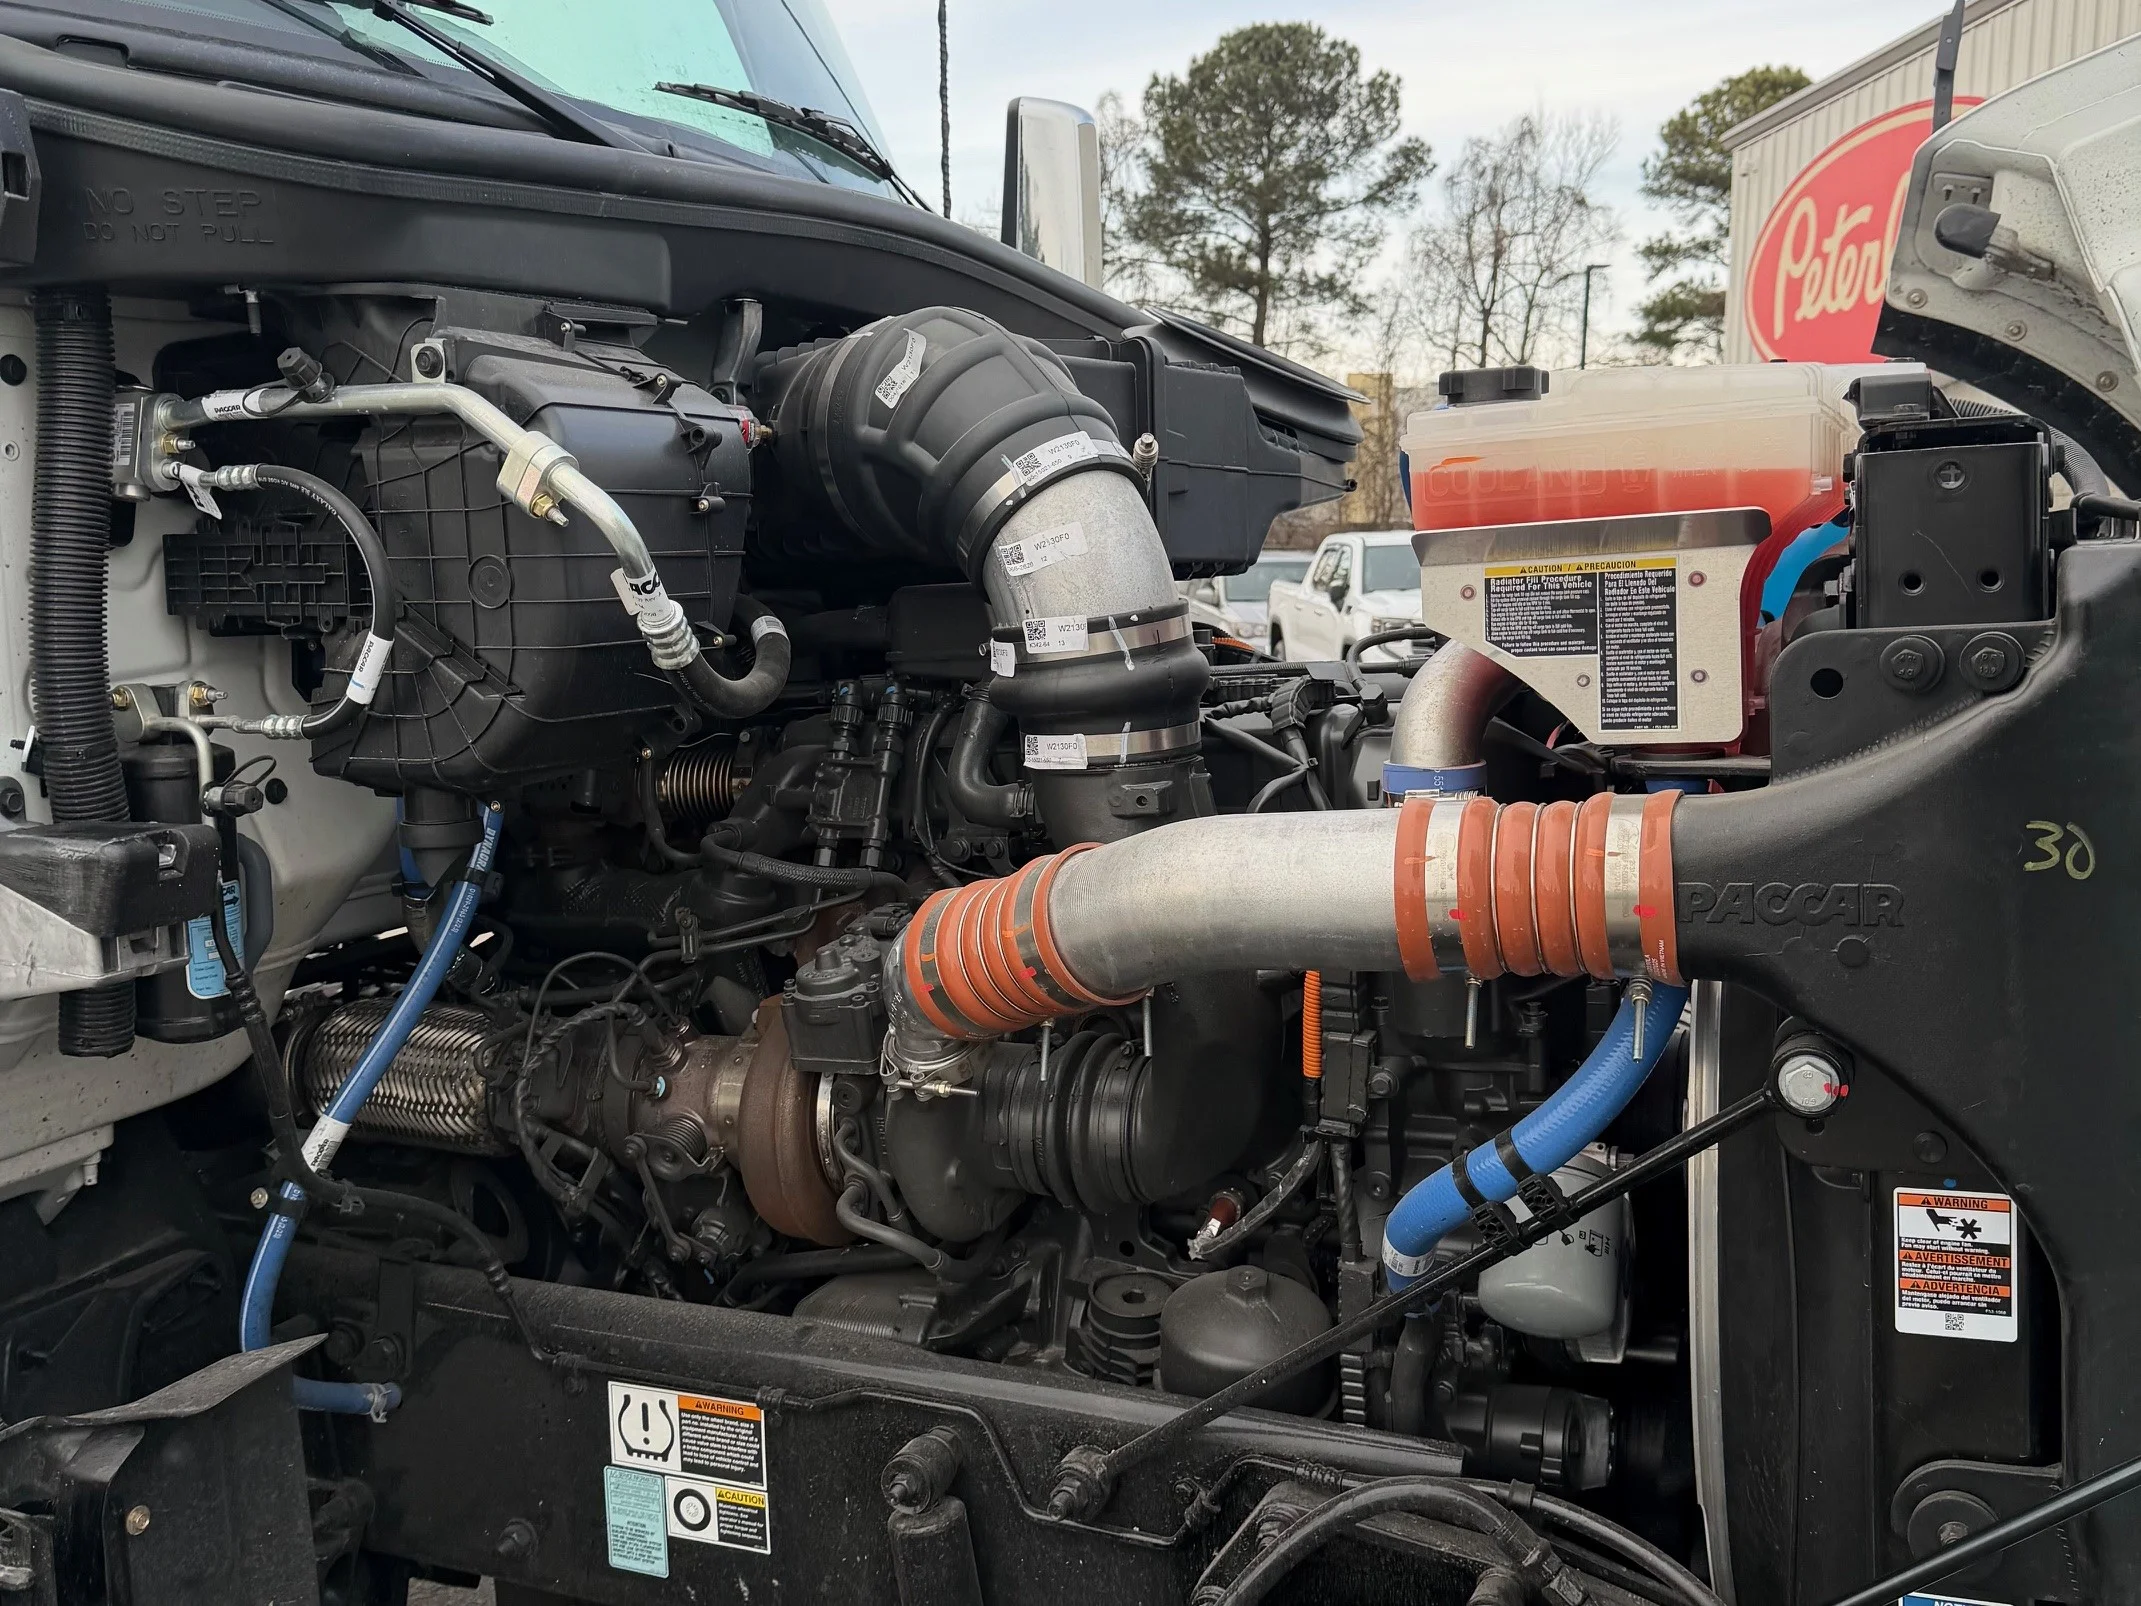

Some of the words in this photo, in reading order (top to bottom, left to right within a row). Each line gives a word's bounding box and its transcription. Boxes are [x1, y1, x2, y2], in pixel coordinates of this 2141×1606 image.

[85, 187, 134, 214] NO
[162, 189, 262, 216] STEP
[83, 222, 115, 240] DO
[132, 223, 180, 241] NOT
[200, 223, 275, 243] PULL
[214, 405, 241, 413] PACCAR
[1047, 439, 1080, 455] W2130F0
[1428, 455, 1593, 498] COOLANT
[311, 492, 337, 516] GALAXY
[1033, 532, 1070, 551] W2130F0
[1528, 564, 1562, 574] CAUTION
[1584, 561, 1636, 570] PRECAUCION
[1490, 577, 1523, 585] Radiator
[1541, 574, 1581, 583] Procedure
[1604, 571, 1643, 580] Procedimiento
[1644, 569, 1672, 578] Requerido
[1490, 583, 1525, 593] Required
[1527, 582, 1540, 590] For
[1543, 581, 1559, 589] This
[1562, 580, 1592, 588] Vehicle
[1624, 579, 1645, 587] Llenado
[1604, 587, 1628, 595] Radiador
[1638, 586, 1650, 594] Este
[1046, 742, 1078, 750] W2130F0
[222, 886, 236, 895] CAR
[1677, 881, 1904, 928] PACCAR
[1933, 1197, 1987, 1208] WARNING
[1915, 1251, 2007, 1266] AVERTISSEMENT
[1922, 1280, 1999, 1295] ADVERTENCIA
[1971, 1295, 2000, 1303] ventilador
[702, 1401, 743, 1415] WARNING
[691, 1413, 701, 1421] only
[681, 1424, 705, 1433] equipment
[706, 1429, 738, 1439] manufacturer.
[699, 1421, 719, 1429] installed
[734, 1427, 752, 1435] original
[681, 1431, 701, 1439] different
[700, 1447, 725, 1455] component
[727, 1445, 746, 1453] interfere
[709, 1461, 729, 1469] personal
[715, 1455, 731, 1463] vehicle
[732, 1458, 749, 1466] control
[724, 1491, 763, 1504] CAUTION
[718, 1502, 736, 1510] Maintain
